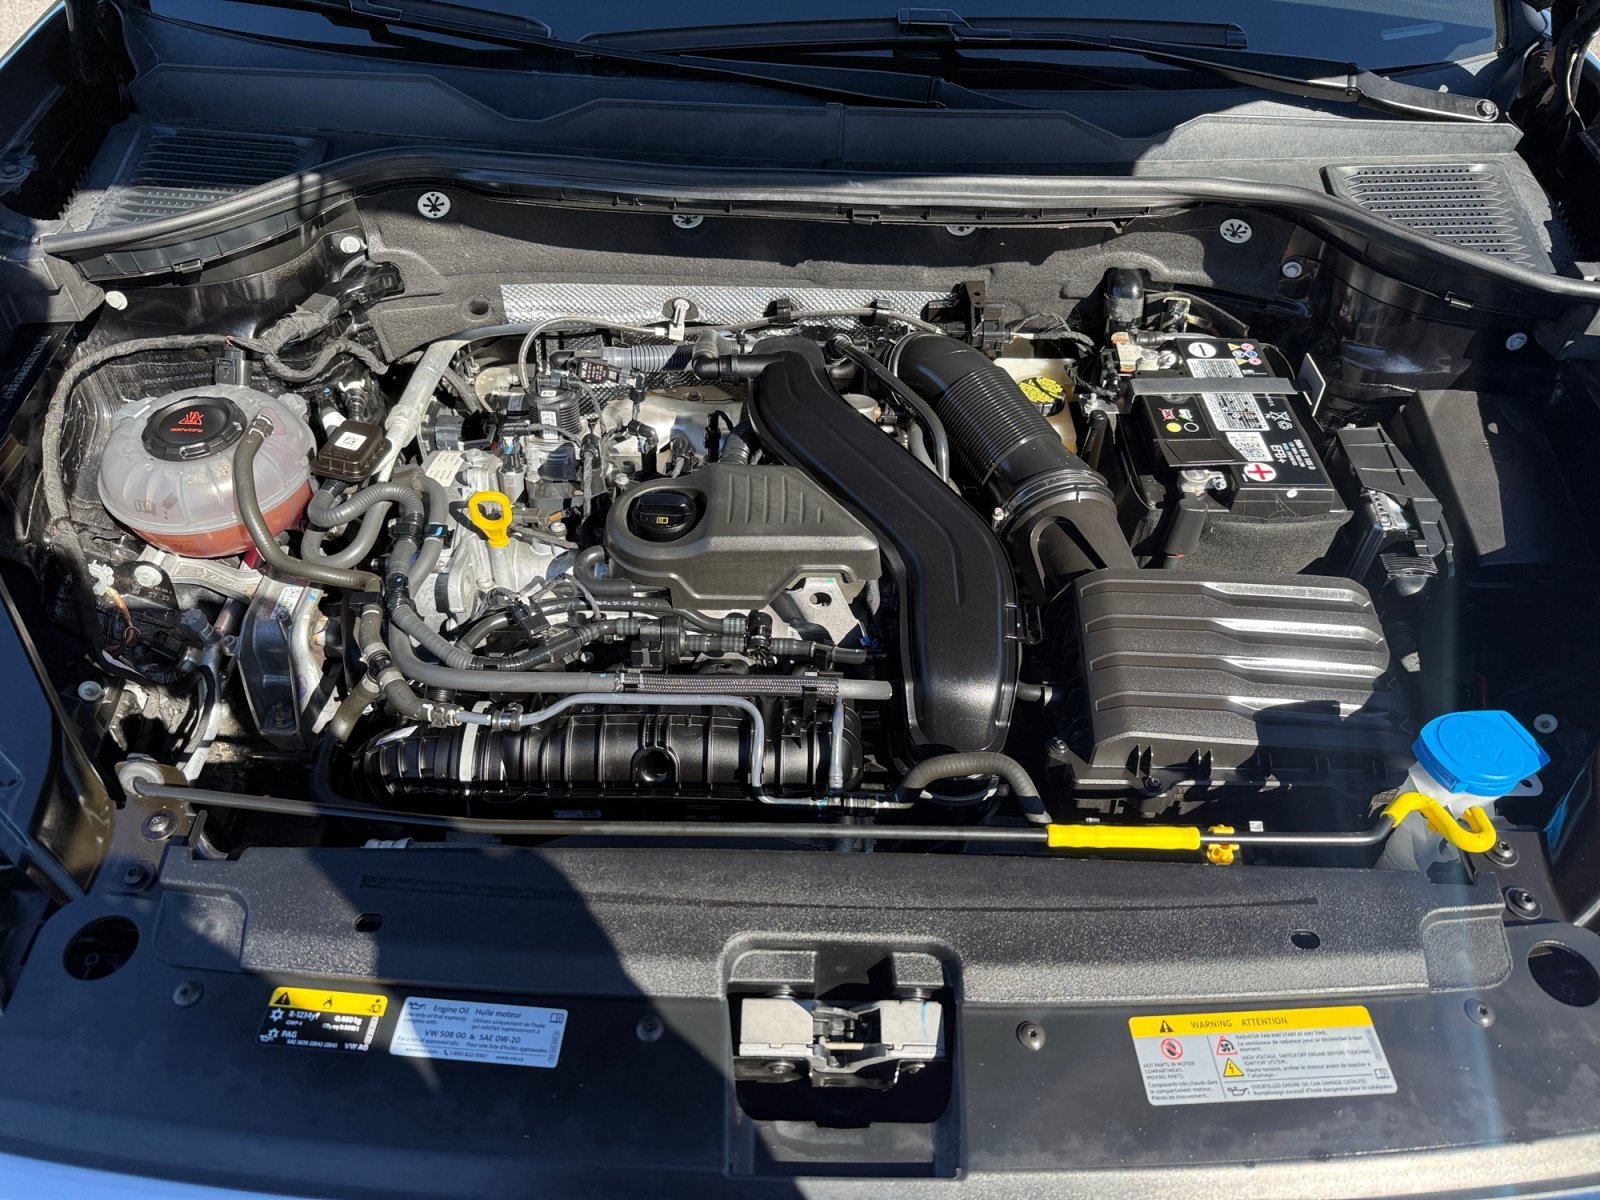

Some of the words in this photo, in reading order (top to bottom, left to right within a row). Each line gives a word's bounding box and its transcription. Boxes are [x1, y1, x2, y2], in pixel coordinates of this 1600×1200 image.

[1270, 444, 1287, 464] EFB+
[433, 1005, 457, 1014] Engine
[475, 1008, 494, 1016] Huile
[288, 1011, 320, 1021] R-1234yf
[1191, 1019, 1232, 1029] WARNING
[1242, 1017, 1288, 1026] ATTENTION
[281, 1030, 298, 1038] PAG
[440, 1030, 454, 1038] 508
[479, 1033, 494, 1042] SAE
[495, 1035, 521, 1044] 0W-20
